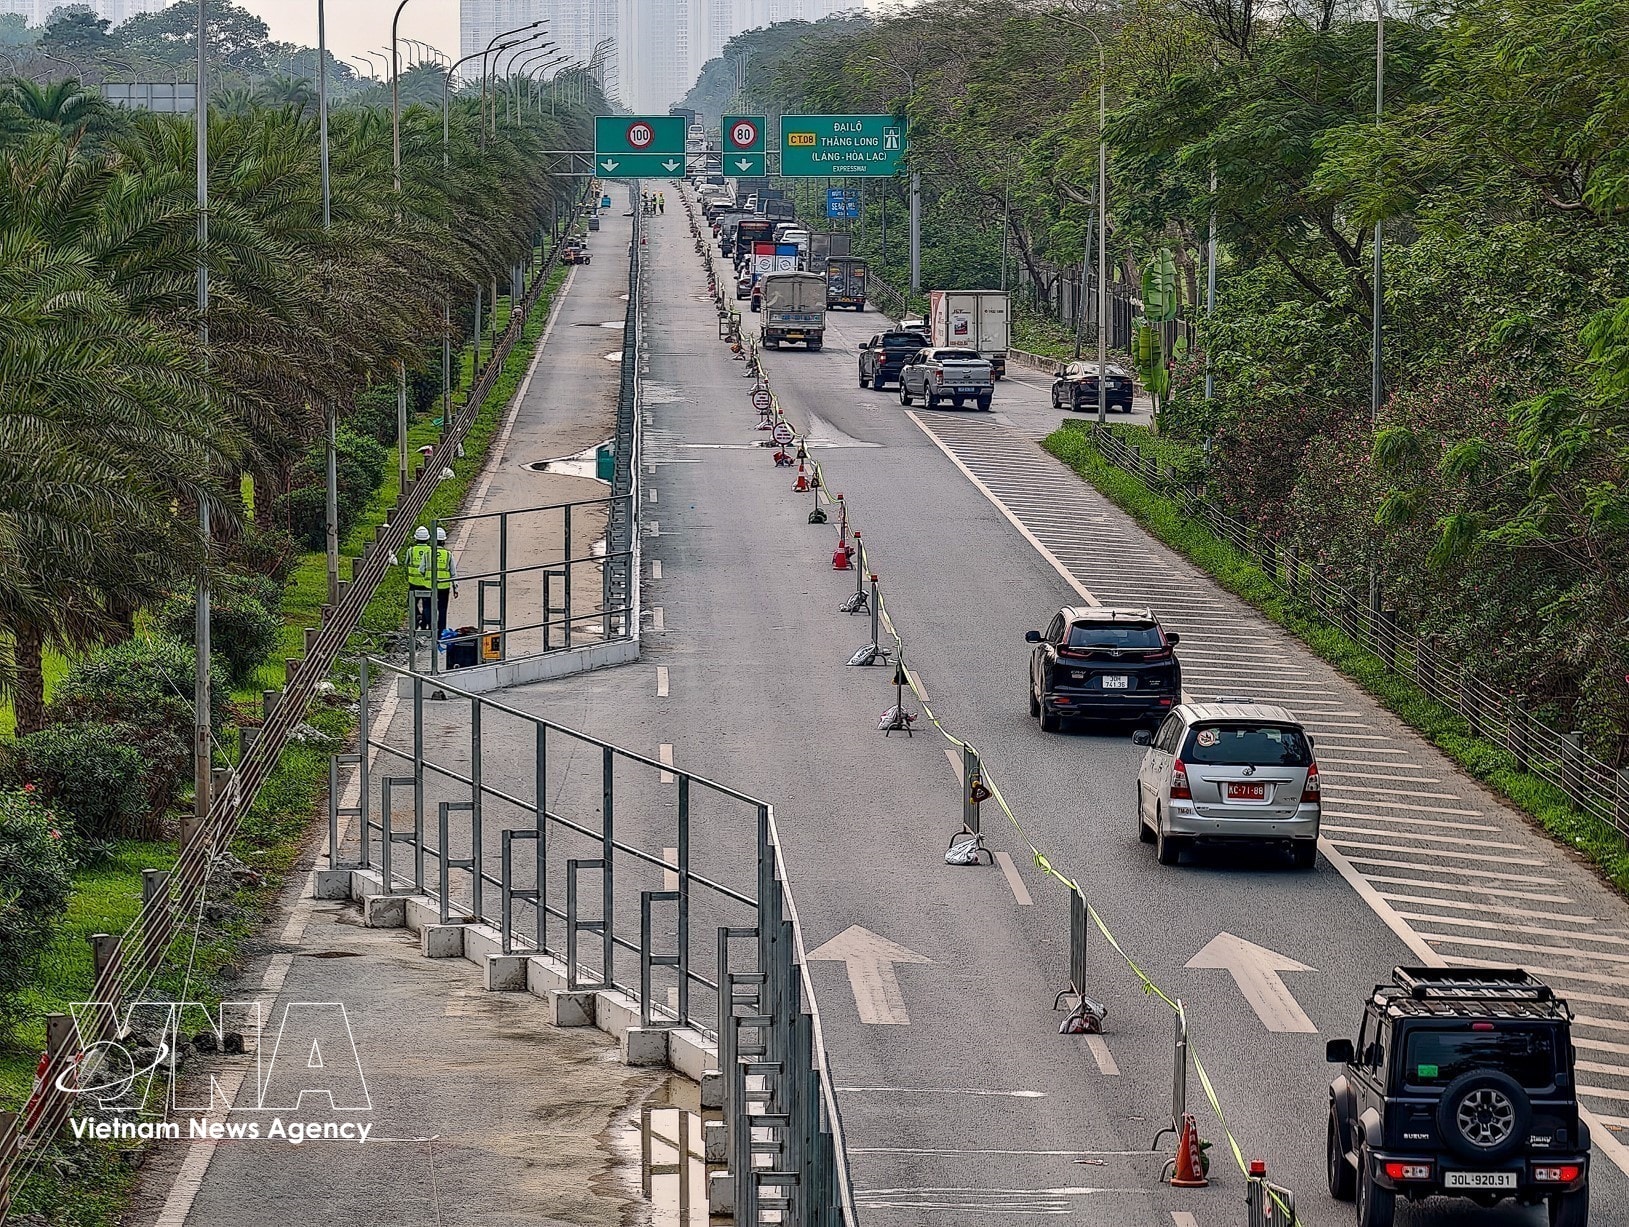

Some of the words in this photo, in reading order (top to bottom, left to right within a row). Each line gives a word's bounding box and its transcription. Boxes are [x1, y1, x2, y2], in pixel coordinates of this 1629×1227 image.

[833, 122, 849, 134] ĐẠI
[850, 120, 862, 133] LỘ
[632, 129, 649, 141] 100
[737, 128, 751, 141] 80
[790, 135, 814, 144] CT.08
[854, 137, 879, 146] LONG
[866, 151, 887, 163] LẠC)
